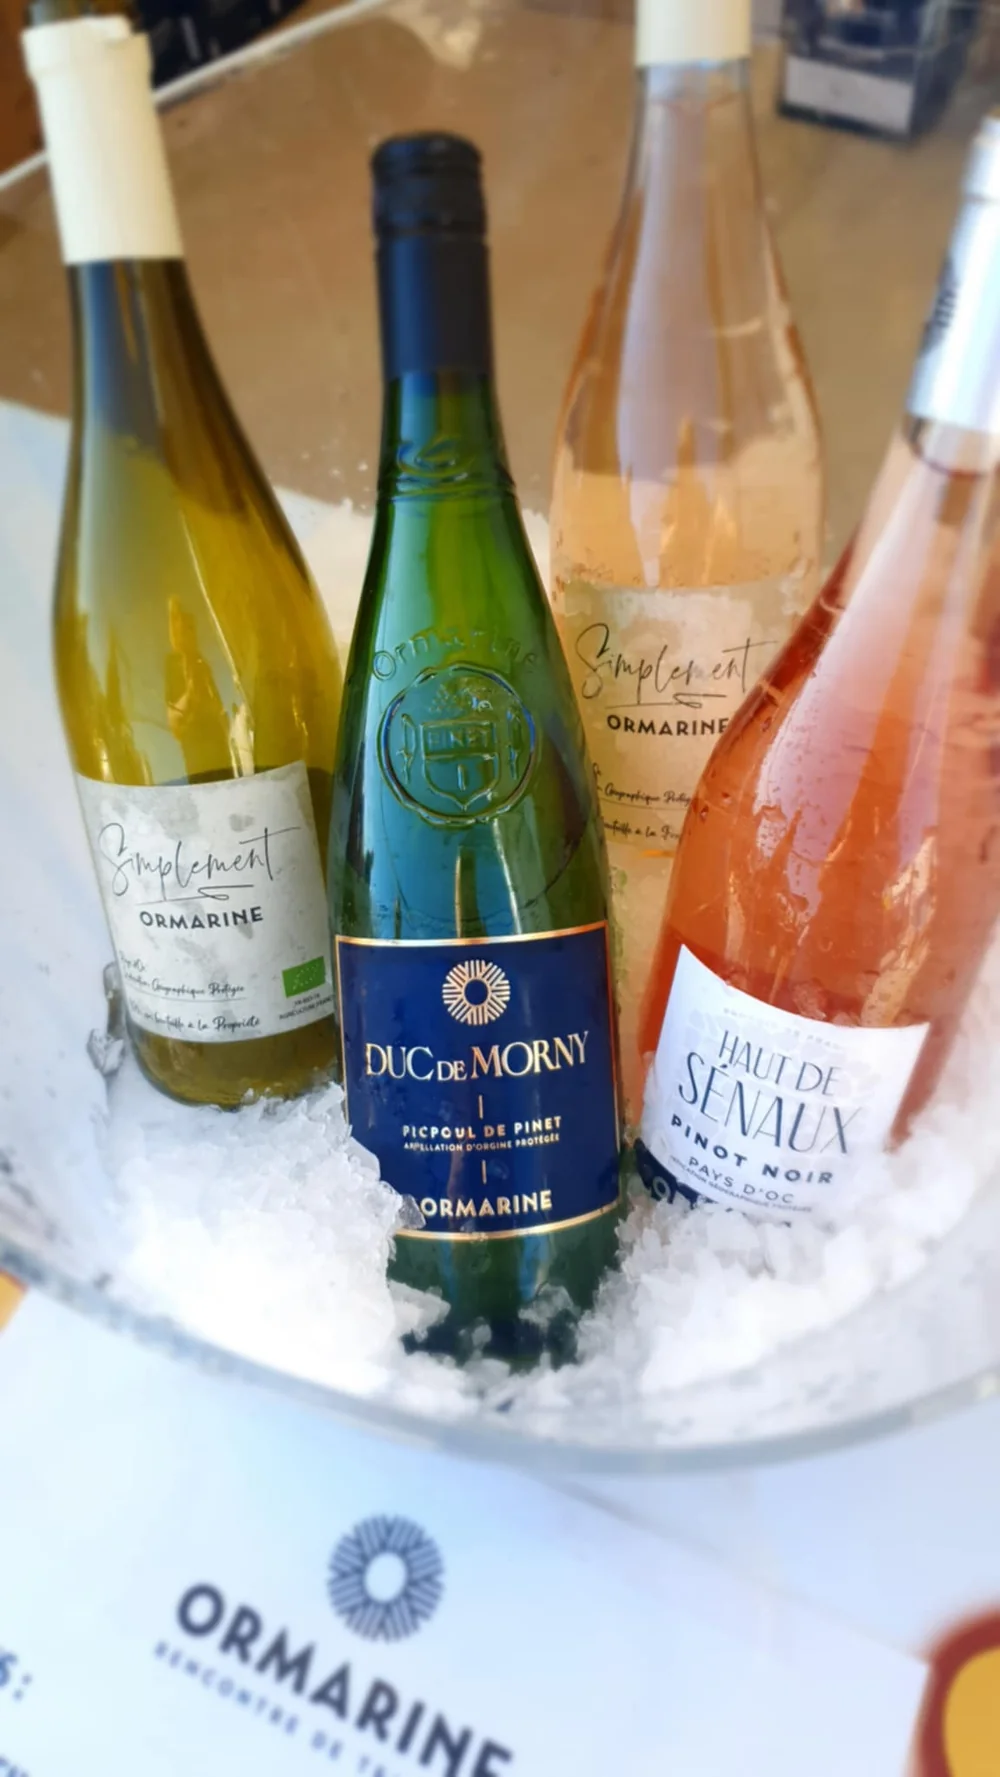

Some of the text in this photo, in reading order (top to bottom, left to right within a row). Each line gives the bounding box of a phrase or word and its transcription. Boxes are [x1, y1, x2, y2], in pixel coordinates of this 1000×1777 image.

[575, 623, 778, 705] Simplement
[606, 713, 729, 737] ORMARINE
[97, 822, 301, 901] Simplement
[139, 906, 265, 930] ORMARINE
[365, 1030, 589, 1082] DUC DE MORNY
[719, 1029, 841, 1096] HAUT DE
[402, 1115, 562, 1140] PICPOUL DE PINET
[678, 1051, 863, 1155] SÉNAUX
[671, 1113, 834, 1185] PINOT NOIR
[688, 1156, 795, 1205] PAYS D'OC
[421, 1189, 553, 1219] ORMARINE
[153, 1640, 301, 1736] RENCONTRE
[176, 1582, 514, 1777] ORMARINE
